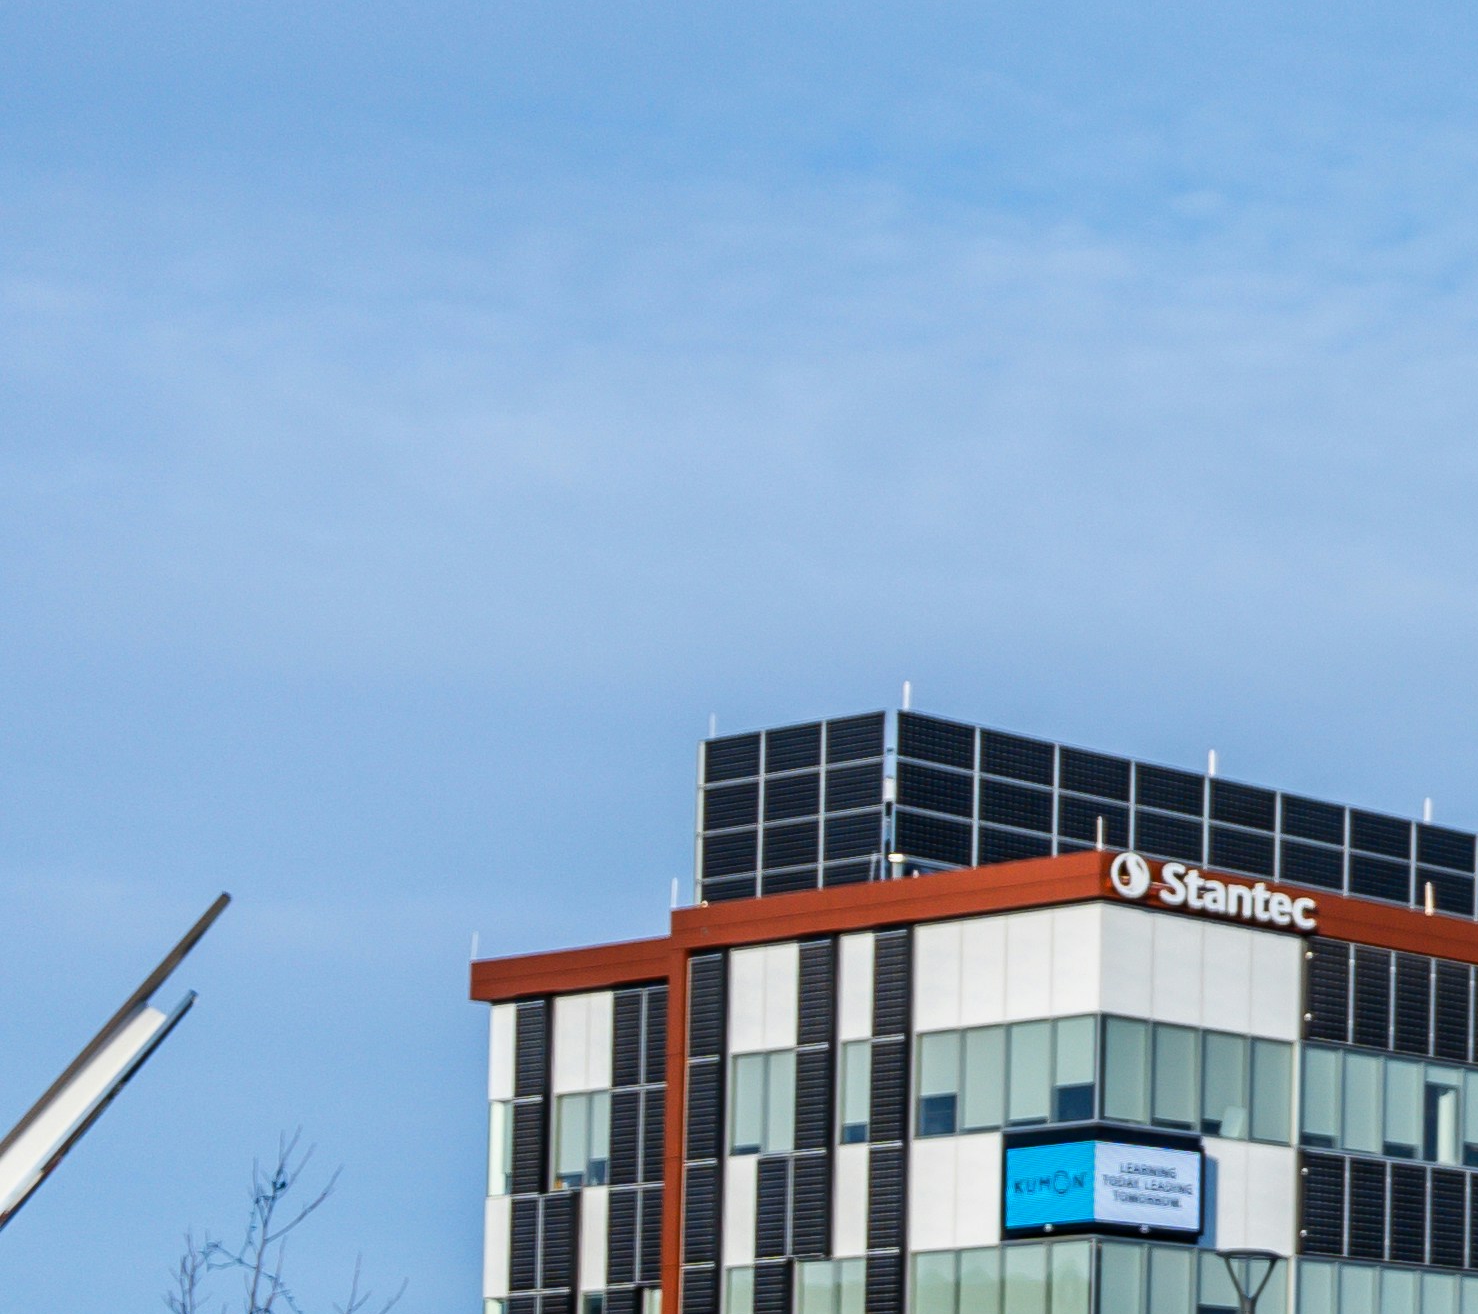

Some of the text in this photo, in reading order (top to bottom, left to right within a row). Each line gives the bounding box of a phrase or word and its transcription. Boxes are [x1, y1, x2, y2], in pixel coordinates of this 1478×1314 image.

[1158, 861, 1317, 931] Stantec
[1120, 1161, 1177, 1179] LEARNING
[1014, 1170, 1086, 1195] KUMON
[1145, 1179, 1193, 1195] LEADING
